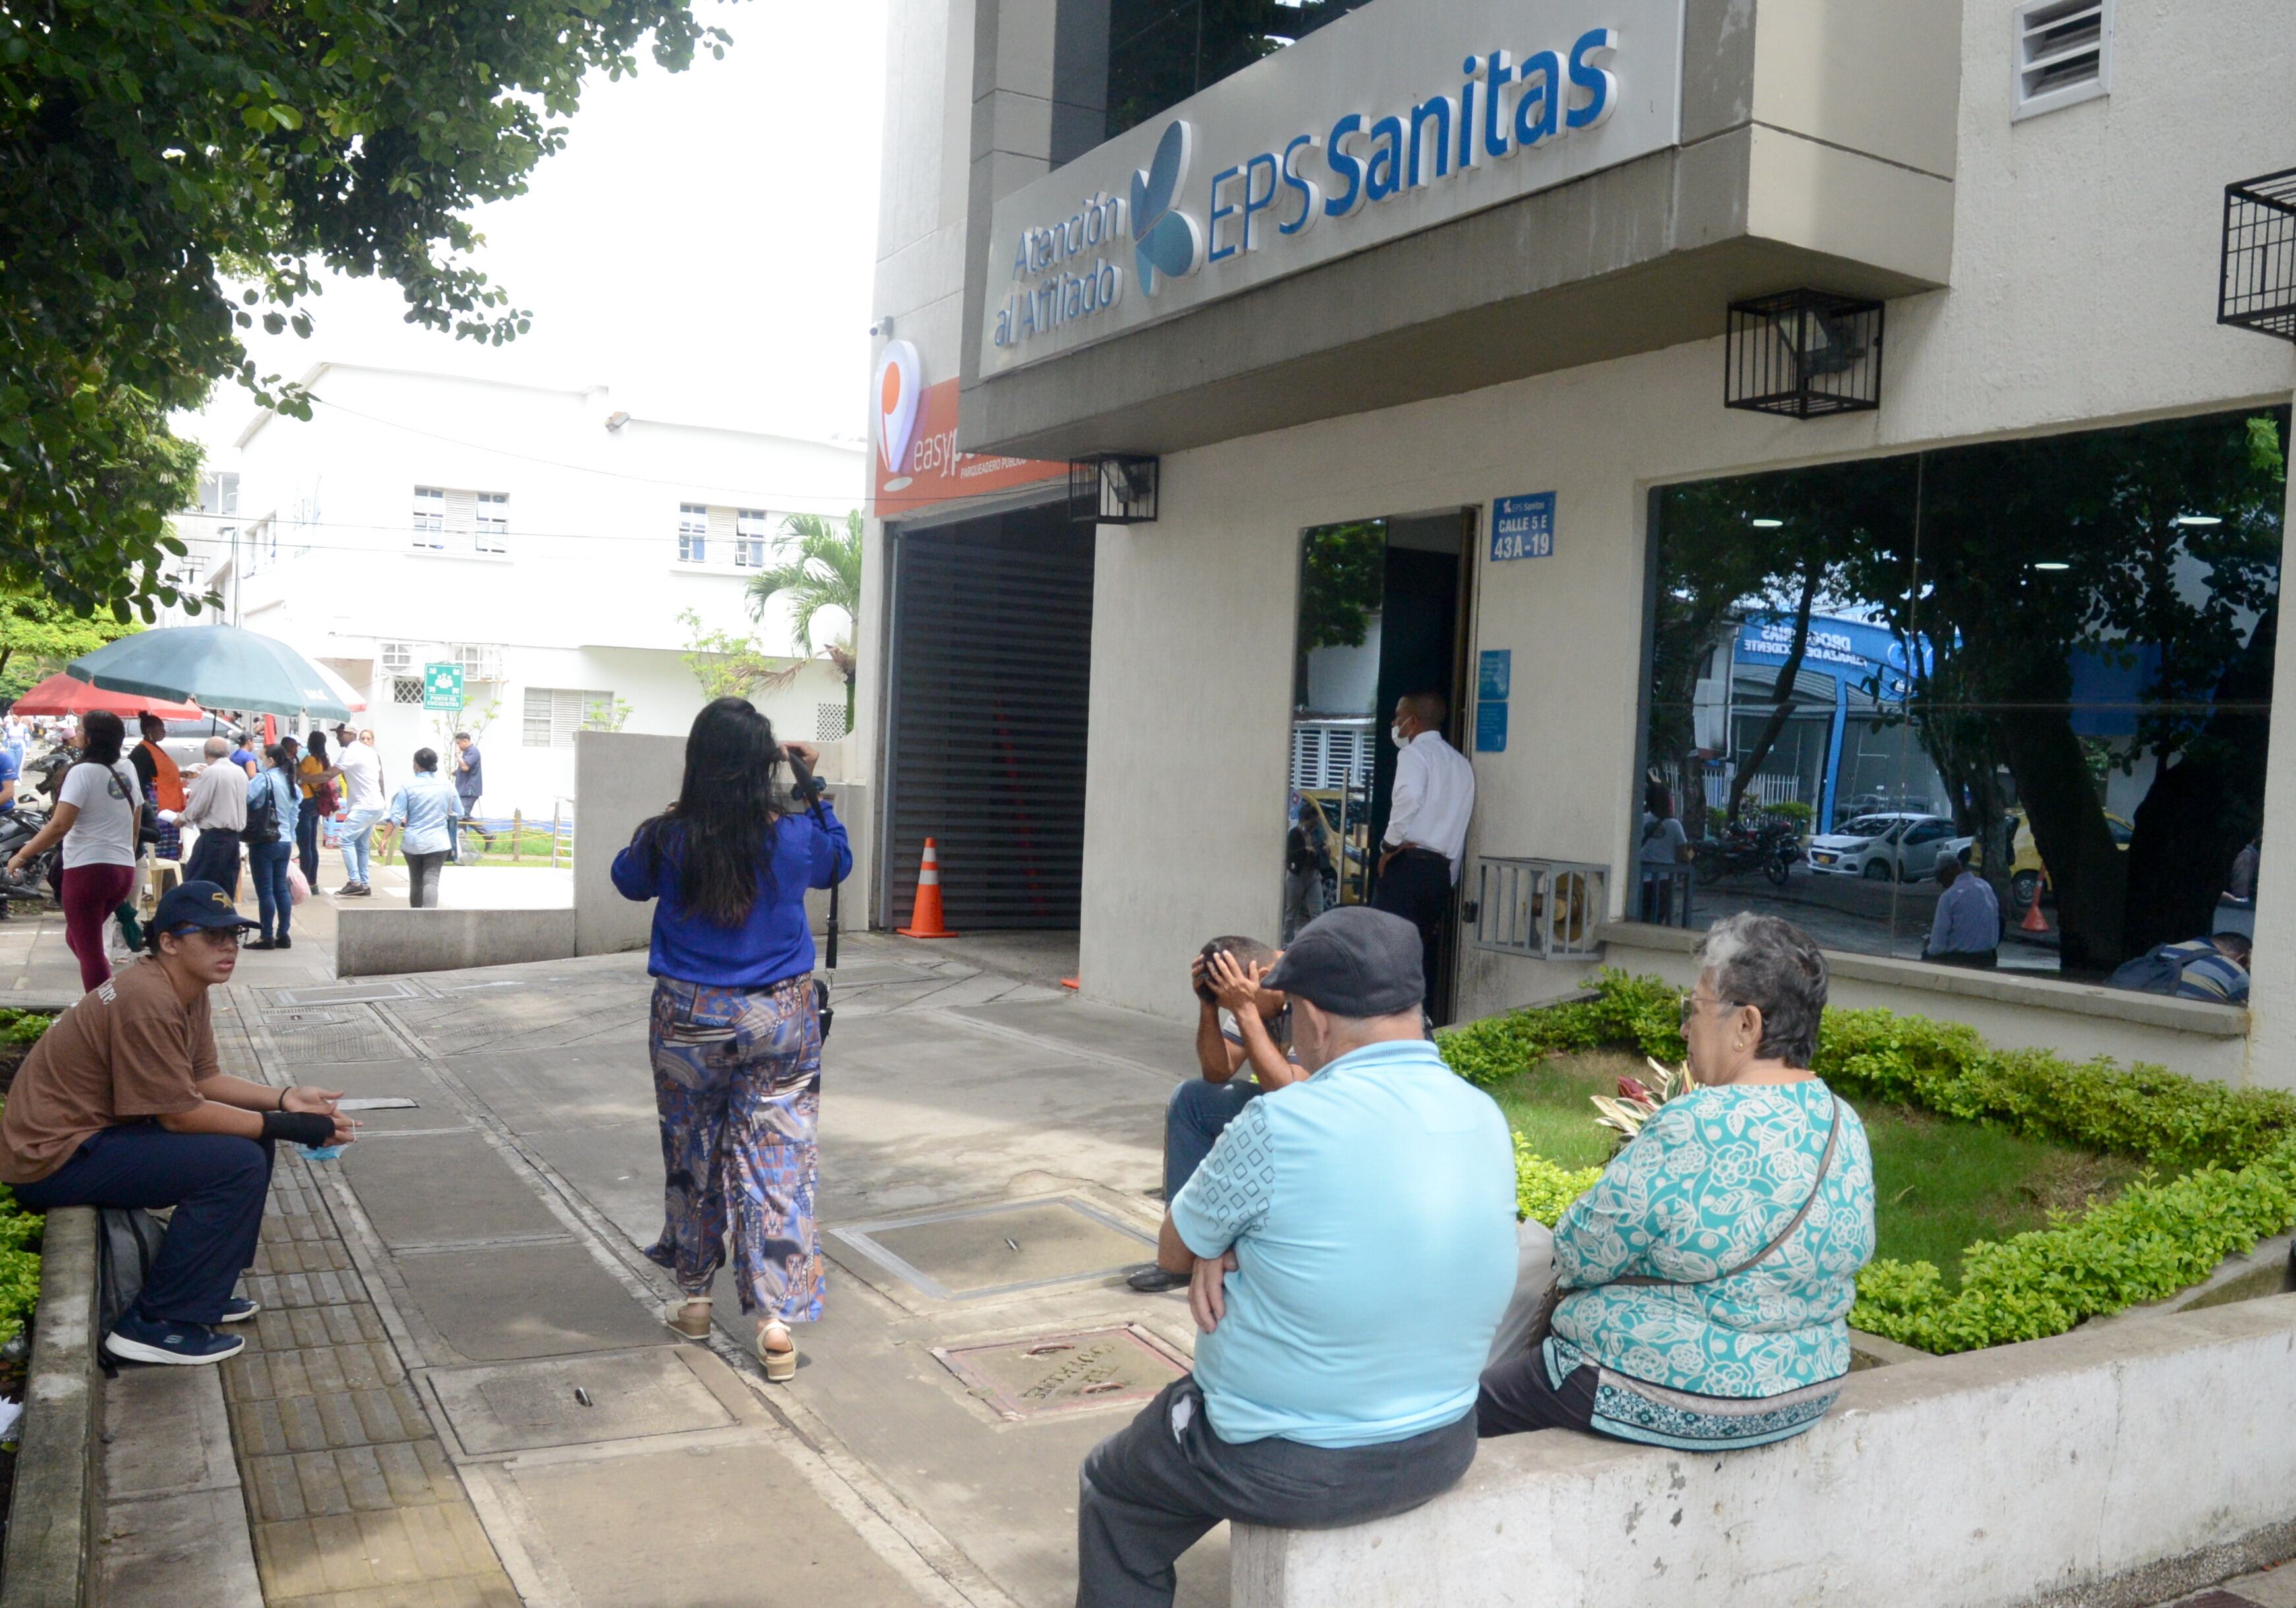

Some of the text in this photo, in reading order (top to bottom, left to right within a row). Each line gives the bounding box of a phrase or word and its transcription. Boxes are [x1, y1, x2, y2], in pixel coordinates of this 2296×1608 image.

[1209, 28, 1617, 262] EPS Sanitas
[1013, 191, 1126, 280] Atención
[995, 258, 1122, 347] al Afiliado
[960, 458, 1001, 479] PARQUEADERO
[1524, 501, 1544, 511] Sanitas
[1499, 514, 1548, 533] CALLE 5 E
[1494, 533, 1549, 558] 43A-19
